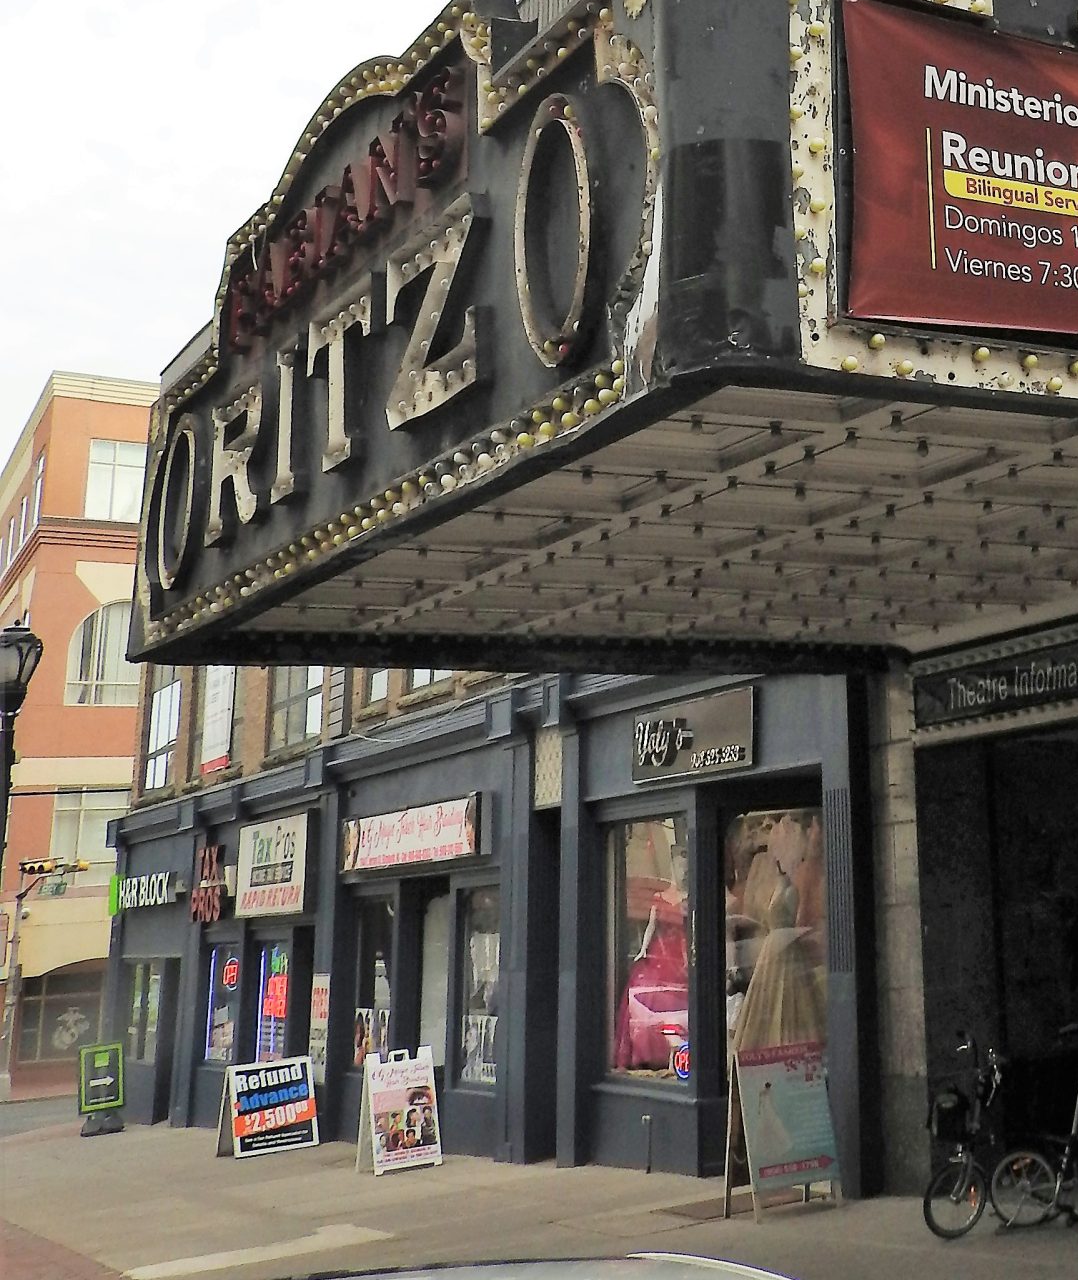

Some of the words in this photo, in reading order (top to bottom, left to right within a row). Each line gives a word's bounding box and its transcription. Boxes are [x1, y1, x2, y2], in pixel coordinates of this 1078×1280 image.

[965, 177, 1039, 205] Bilingual
[944, 204, 1064, 249] Domingos
[944, 247, 1033, 283] Viernes
[204, 192, 478, 548] RITZ
[948, 677, 1008, 710] Theatre
[198, 845, 223, 882] TAX
[252, 830, 273, 865] Tax
[274, 825, 296, 860] Pros
[118, 876, 138, 910] H&R
[138, 871, 170, 907] BLOCK
[191, 883, 221, 922] PROS
[236, 1063, 303, 1093] Refund
[239, 1083, 309, 1111] Advance
